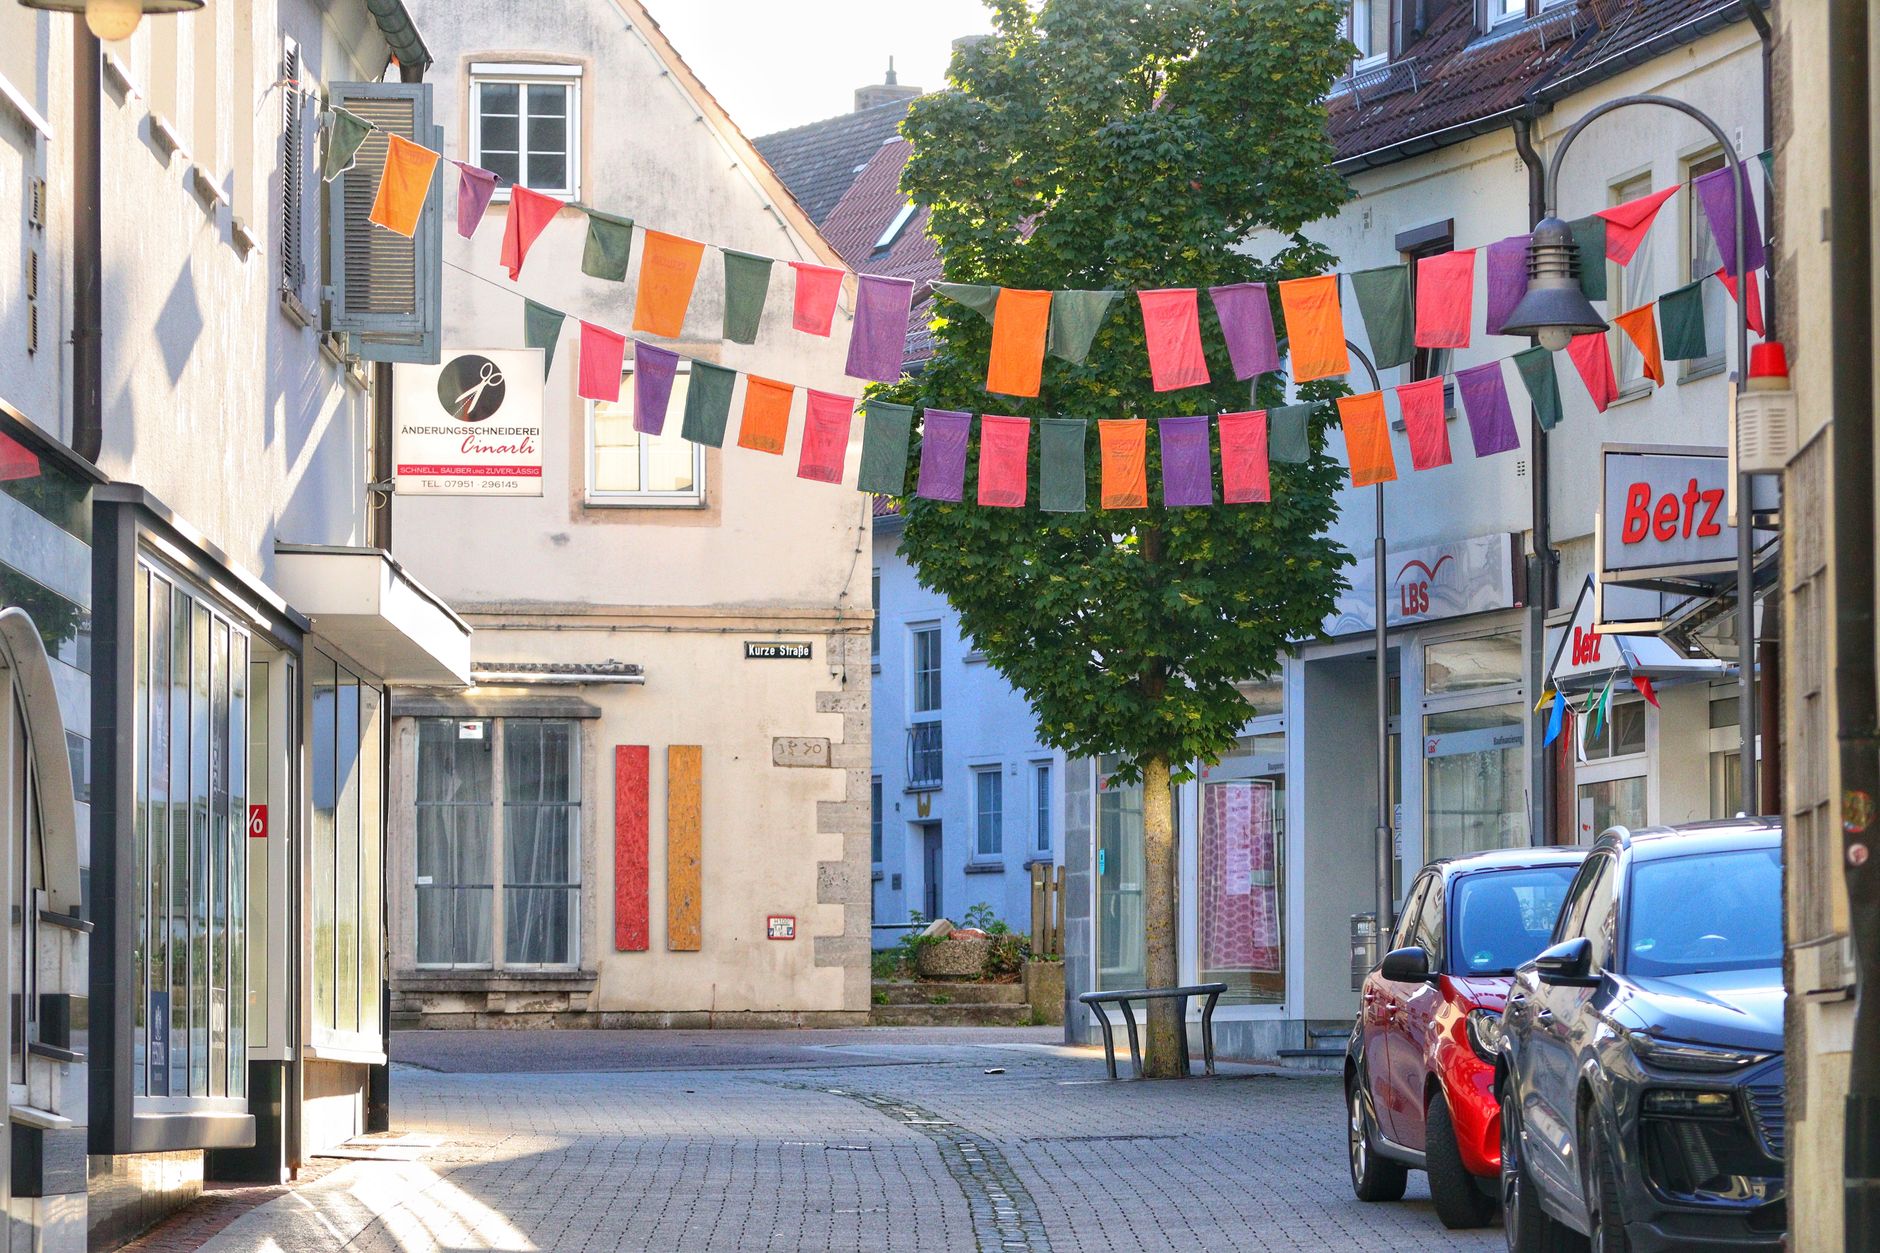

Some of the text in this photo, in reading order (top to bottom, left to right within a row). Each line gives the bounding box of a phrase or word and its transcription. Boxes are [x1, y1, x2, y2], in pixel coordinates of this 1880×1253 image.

[401, 424, 540, 436] ÄNDERUNGSSCHNEIDEREI
[461, 435, 535, 454] Cinarli
[440, 467, 472, 475] SAUBER
[485, 466, 540, 476] ZUVERLÄSSIG
[421, 480, 442, 488] TEL.
[444, 480, 474, 488] 07951
[481, 480, 518, 488] 296145
[1622, 478, 1724, 544] Betz
[1401, 580, 1430, 616] LBS
[749, 644, 809, 657] Kurze Straße
